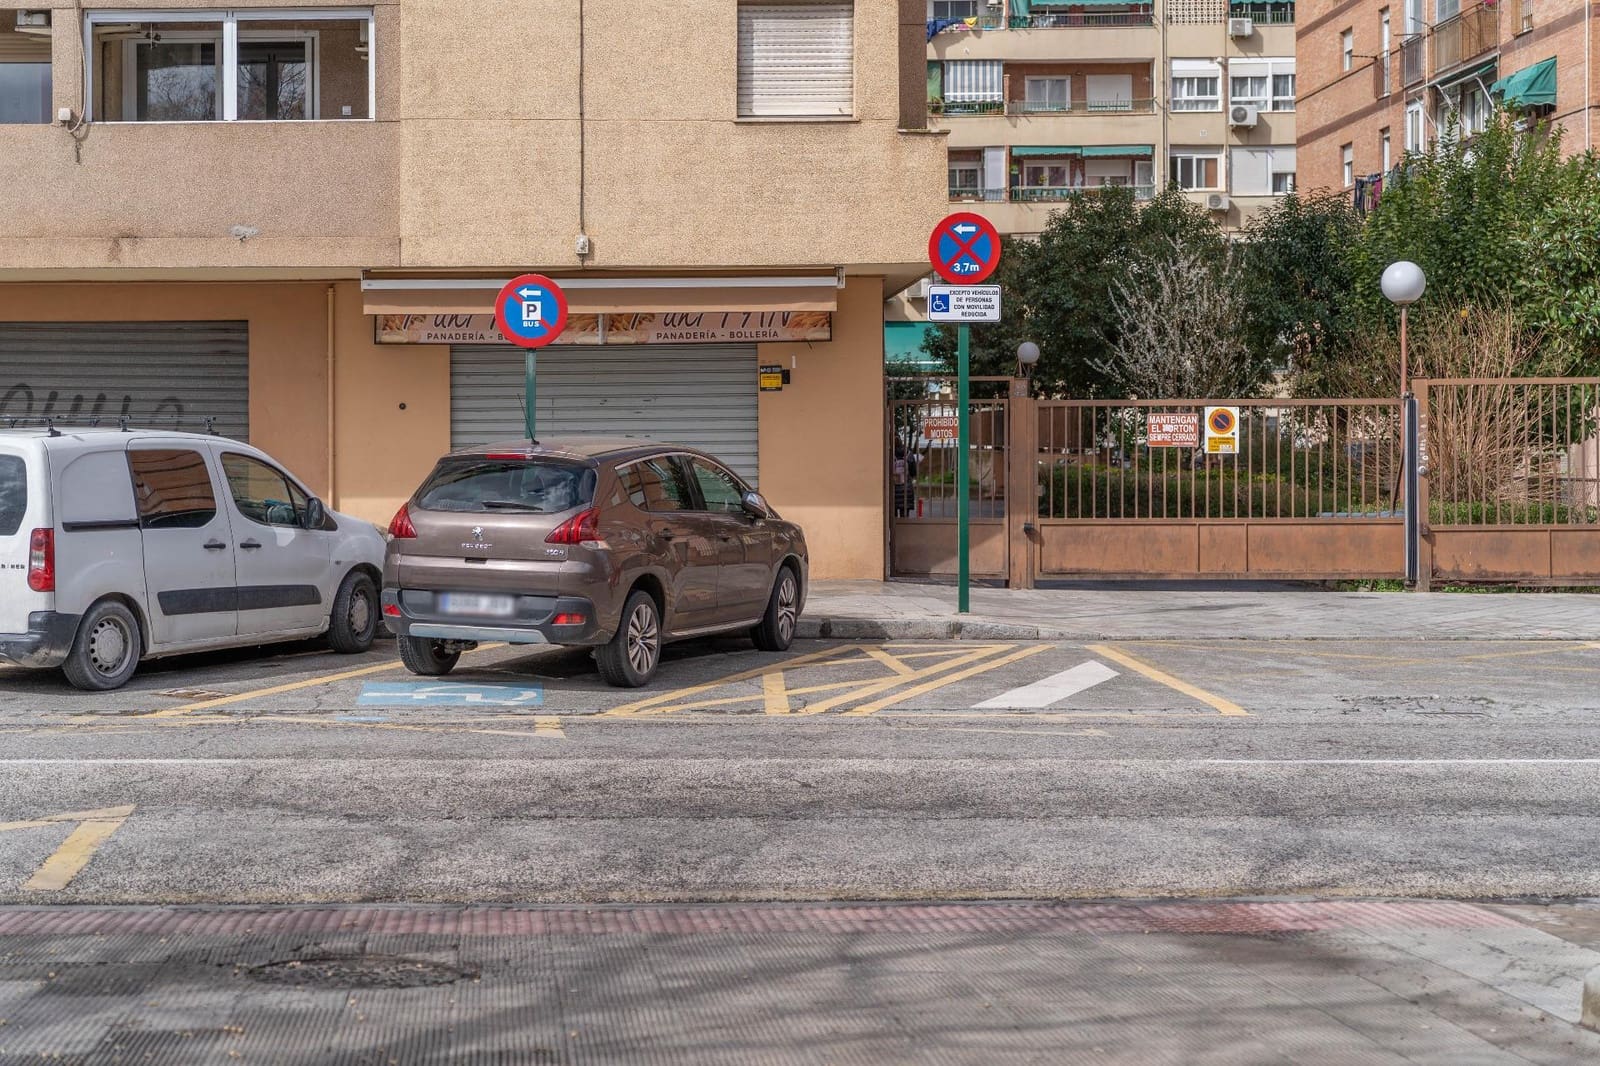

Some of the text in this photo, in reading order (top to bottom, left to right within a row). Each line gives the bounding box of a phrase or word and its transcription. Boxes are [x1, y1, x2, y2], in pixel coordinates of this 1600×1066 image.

[953, 263, 979, 272] 3,7m
[526, 304, 537, 318] P
[427, 331, 485, 340] PANADERÍA
[656, 329, 716, 340] PANADERÍA
[729, 328, 779, 338] BOLLERÍA
[925, 418, 958, 426] PROHIBIDO
[1150, 415, 1197, 423] MANTENGAN
[1151, 424, 1161, 432] EL
[930, 429, 952, 437] MOTOS
[1150, 433, 1197, 441] SIEMPRE CERRADO
